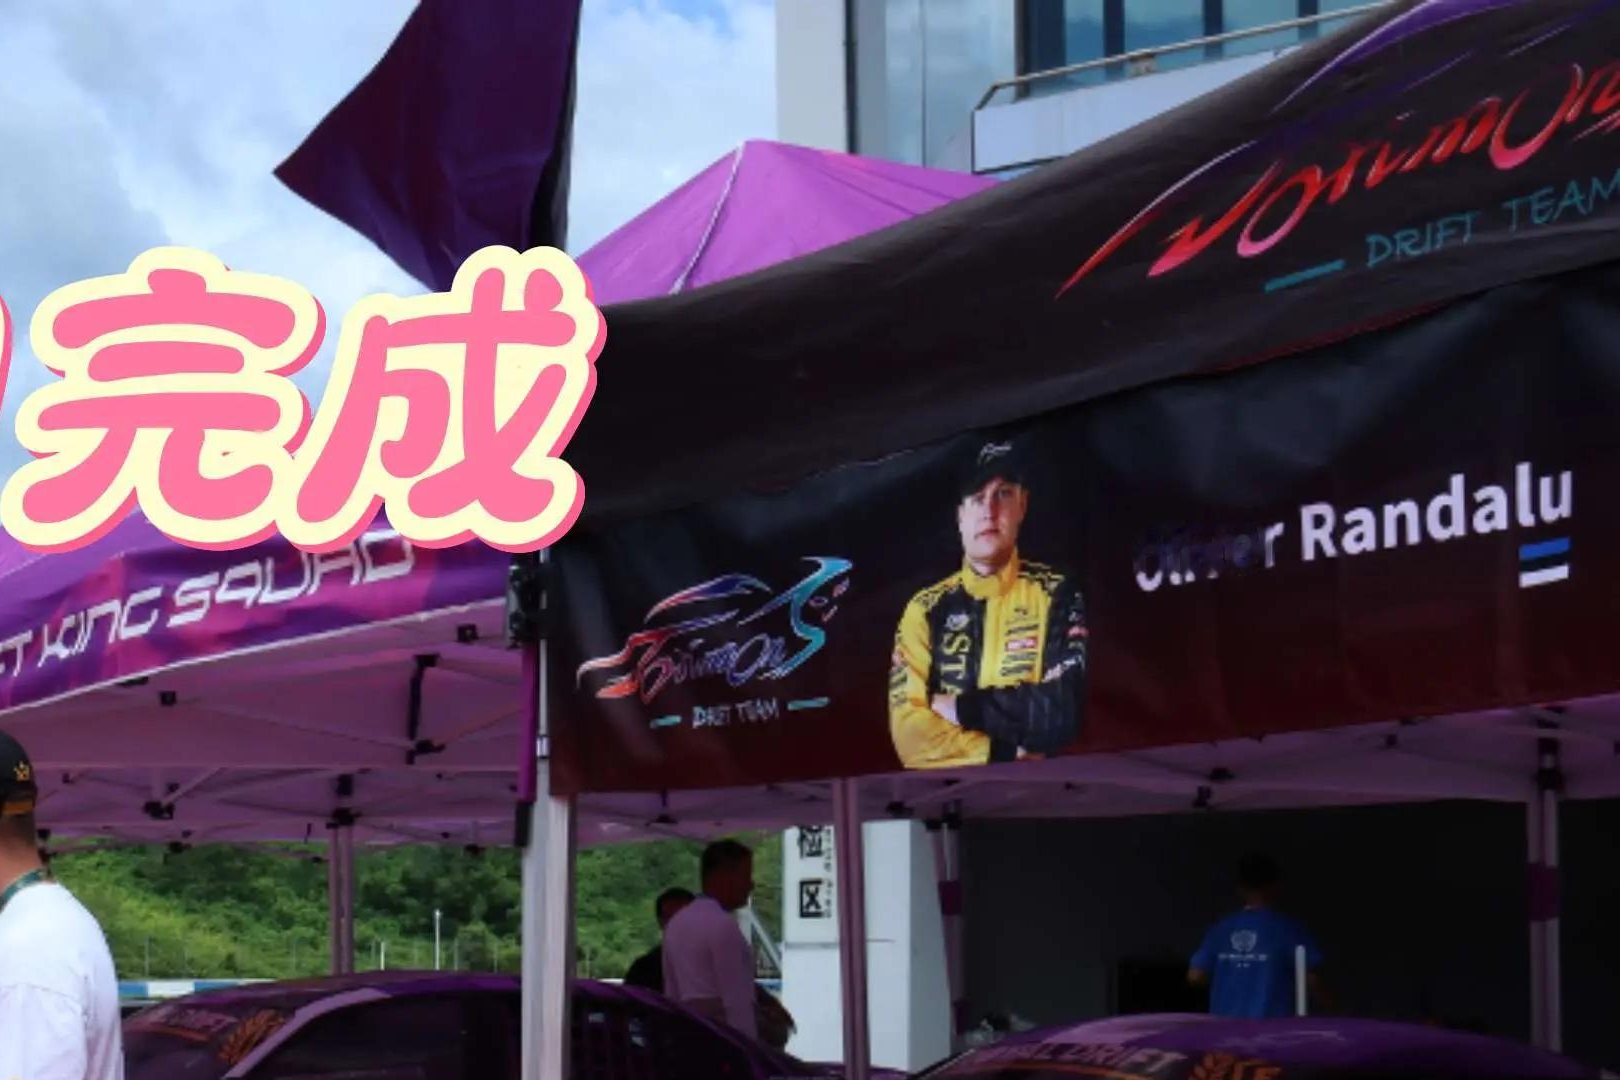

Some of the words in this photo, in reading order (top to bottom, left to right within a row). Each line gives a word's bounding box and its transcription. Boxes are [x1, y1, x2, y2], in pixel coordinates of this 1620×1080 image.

[1366, 208, 1480, 268] DRIFT
[1504, 168, 1620, 231] TEAM
[1300, 462, 1574, 561] Randalu
[36, 587, 164, 668] KING
[166, 528, 416, 629] SQUAD
